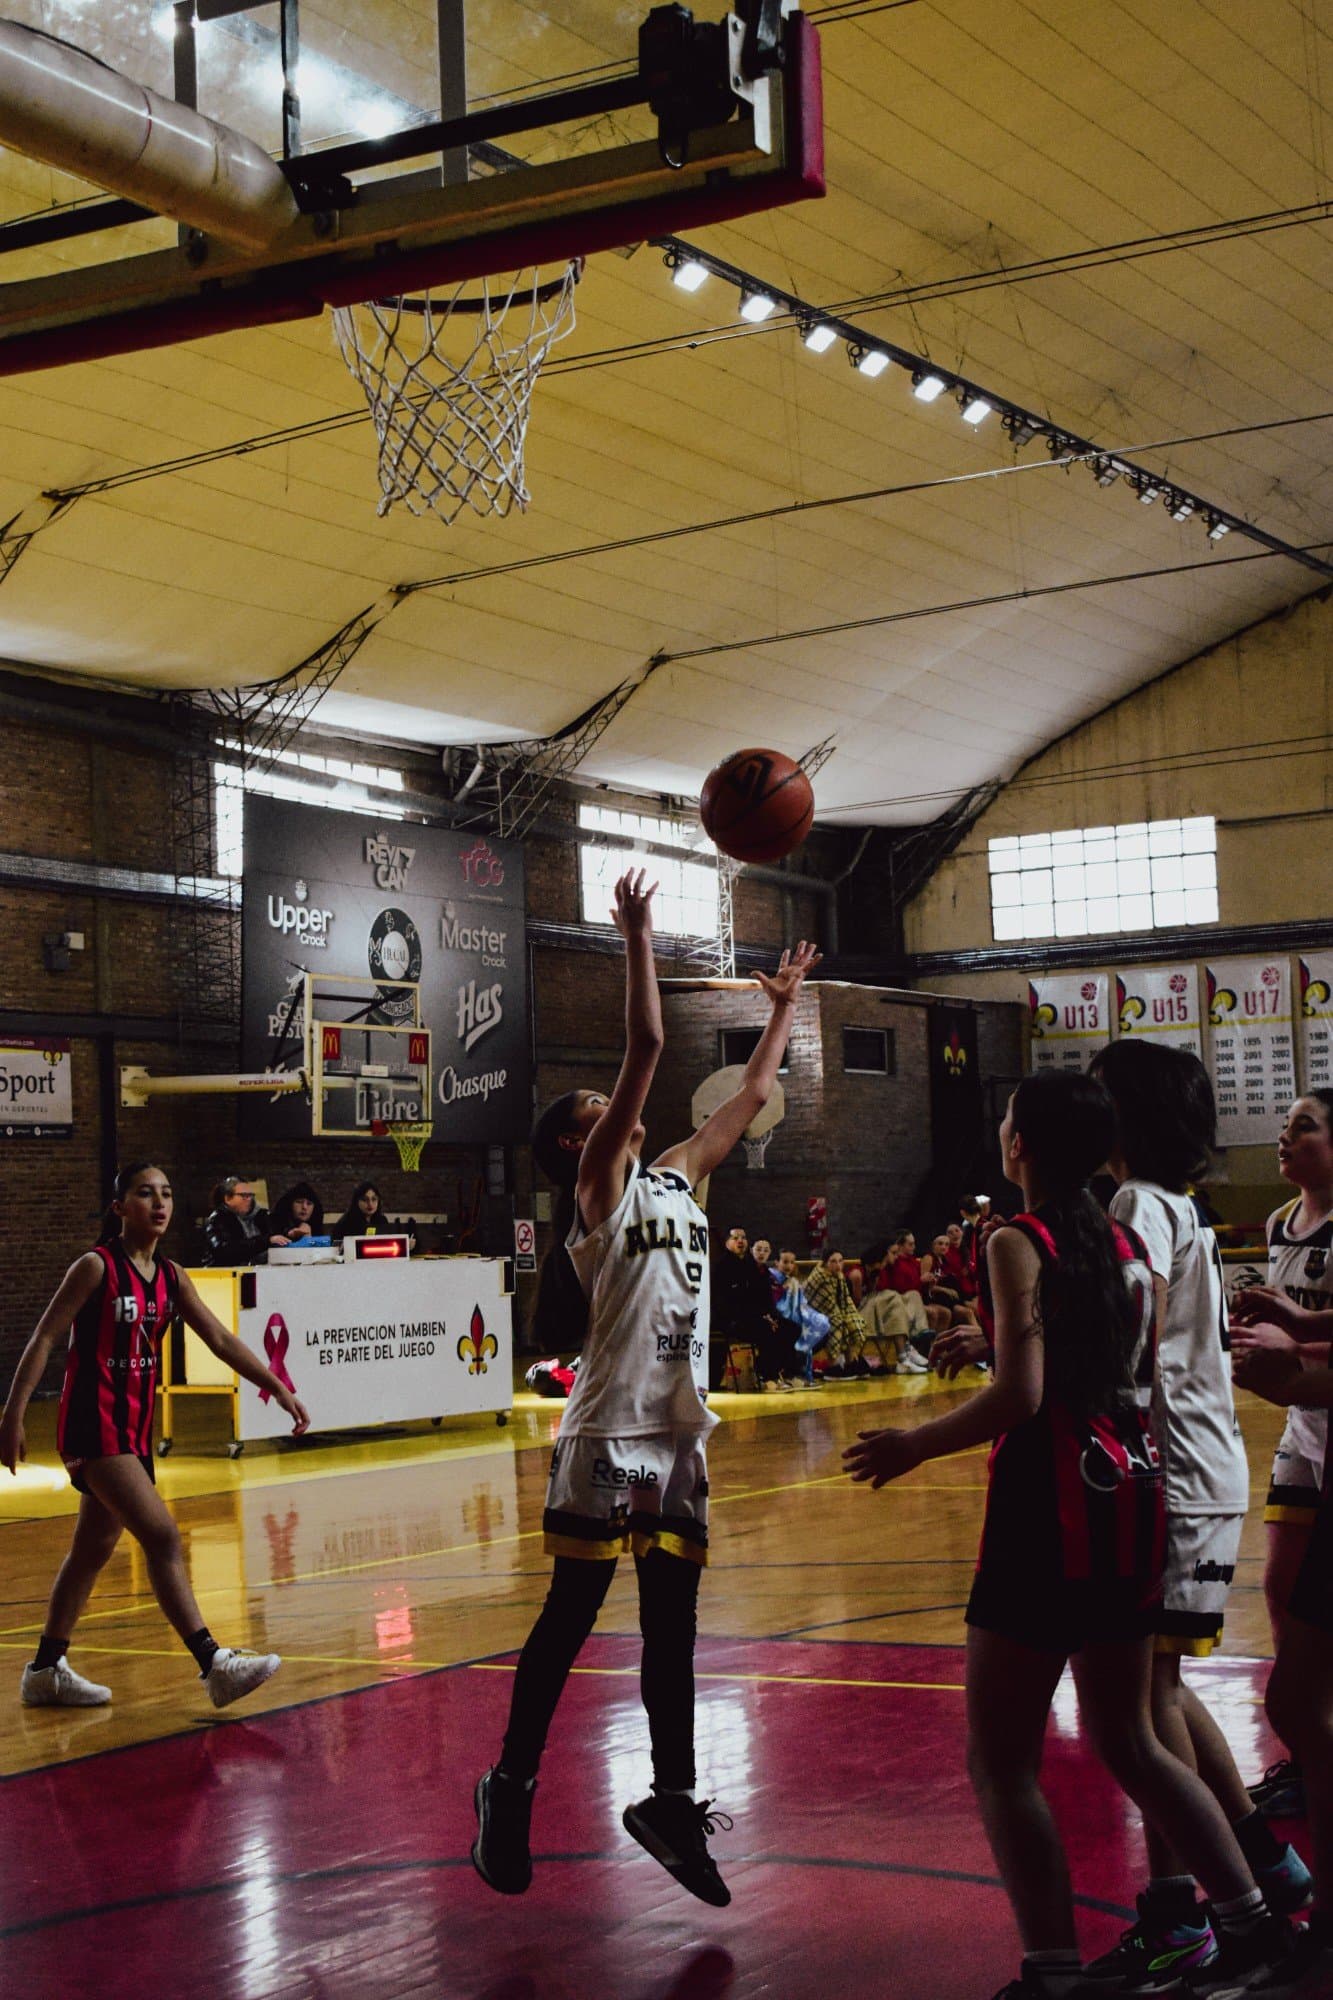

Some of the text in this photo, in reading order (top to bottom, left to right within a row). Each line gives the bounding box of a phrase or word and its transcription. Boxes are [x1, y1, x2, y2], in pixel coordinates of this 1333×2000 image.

[376, 864, 408, 891] CAN
[459, 851, 504, 887] TCG
[268, 895, 333, 935] Upper
[442, 917, 507, 954] Master
[456, 979, 503, 1052] Has
[1153, 997, 1188, 1023] U15
[1245, 989, 1280, 1016] U17
[1065, 1004, 1098, 1030] U13
[0, 1066, 55, 1101] Sport
[438, 1065, 507, 1105] Chasque
[1219, 1091, 1292, 1101] 2011 2012 2013
[1275, 1105, 1291, 1114] 202
[625, 1217, 682, 1258] ALL
[112, 1296, 139, 1323] 15
[306, 1321, 446, 1346] LA PREVENCION TAMBIEN
[320, 1341, 435, 1365] ES PARTE DEL JUEGO
[592, 1458, 658, 1485] Reale
